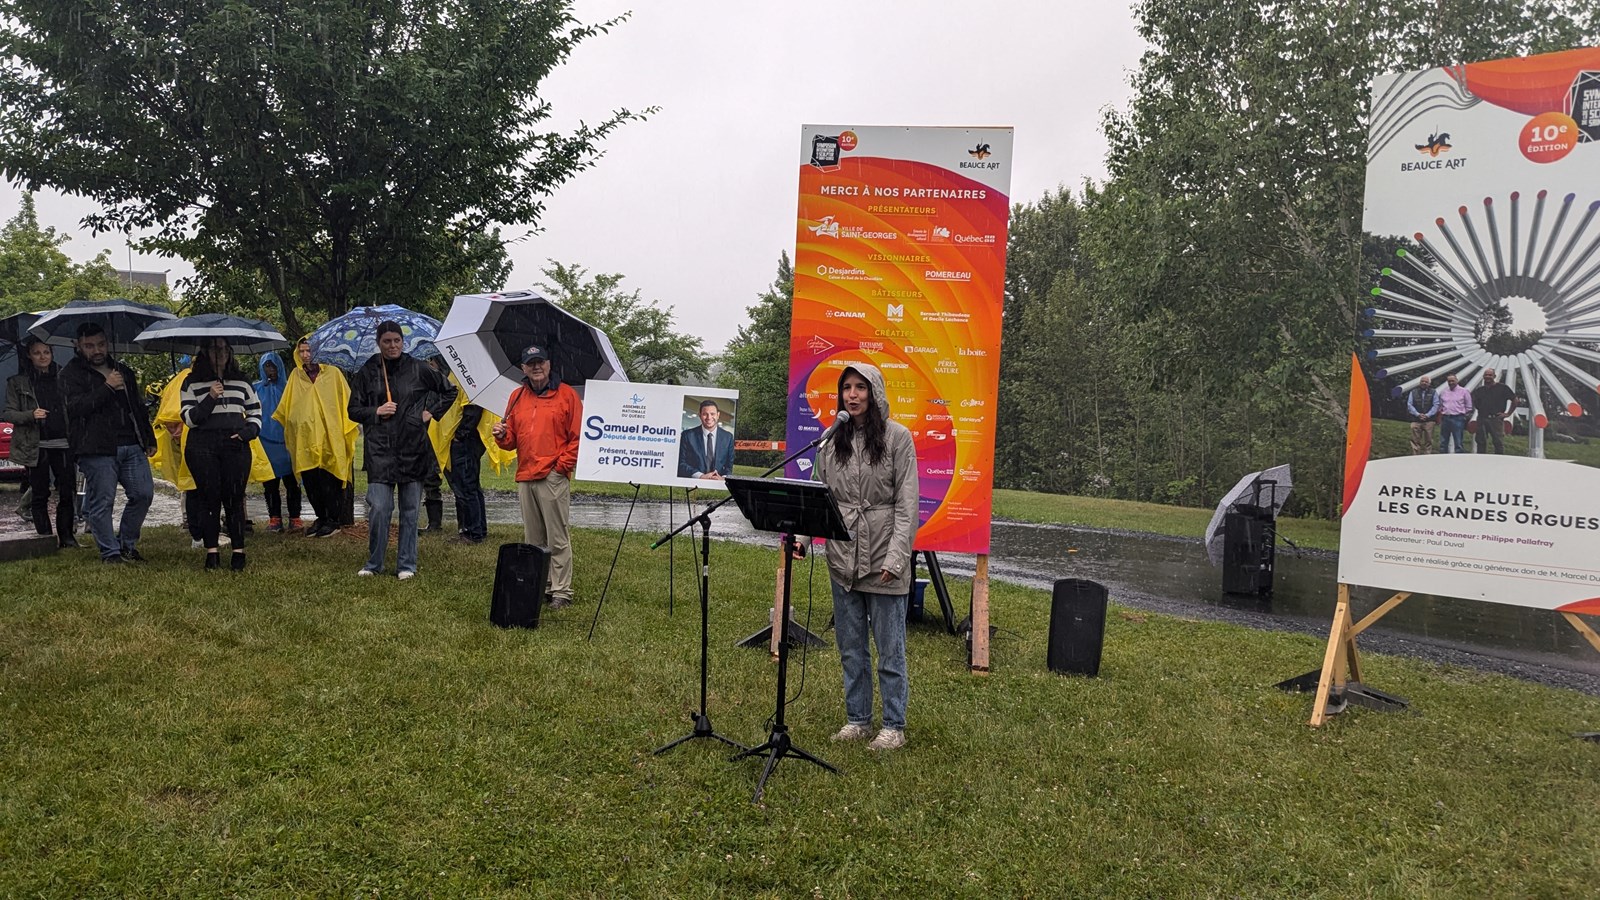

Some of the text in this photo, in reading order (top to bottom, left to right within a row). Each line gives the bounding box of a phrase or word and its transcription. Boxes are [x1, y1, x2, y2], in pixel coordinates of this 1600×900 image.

[1532, 125, 1568, 142] 10e
[1527, 143, 1568, 153] ÉDITION
[987, 162, 1000, 170] ART
[1401, 158, 1467, 172] BEAUCE ART
[821, 184, 986, 199] MERCI À NOS PARTENAIRES
[868, 204, 936, 214] PRÉSENTATEURS
[842, 231, 897, 239] SAINT-GEORGES
[955, 234, 984, 243] Québec
[868, 254, 931, 262] VISIONNAIRES
[829, 267, 865, 275] Desjardins
[925, 271, 971, 279] POMERLEAU
[872, 289, 923, 298] BÂTISSEURS
[834, 311, 866, 319] CANAM
[875, 329, 915, 337] CRÉATIFS
[585, 416, 676, 441] Samuel Poulin
[603, 433, 626, 441] Député
[638, 436, 676, 444] Beauce-Sud
[599, 446, 665, 457] Présent, travaillant
[598, 456, 664, 469] et POSITIF.
[1378, 484, 1539, 510] APRÈS LA PLUIE,
[1378, 501, 1600, 530] LES GRANDES ORGUES
[1376, 524, 1411, 535] Sculpteur
[1413, 527, 1435, 536] invité
[1482, 534, 1514, 544] Philippe
[1516, 537, 1554, 548] Pallafray
[1427, 538, 1442, 546] Paul
[1444, 540, 1464, 548] Duval
[1385, 553, 1405, 563] projet
[1413, 555, 1424, 563] été
[1426, 556, 1449, 566] réalisé
[1451, 559, 1472, 569] grâce
[1484, 562, 1519, 574] généreux
[1521, 566, 1536, 576] don
[1550, 570, 1559, 578] M.
[1561, 572, 1587, 580] Marcel
